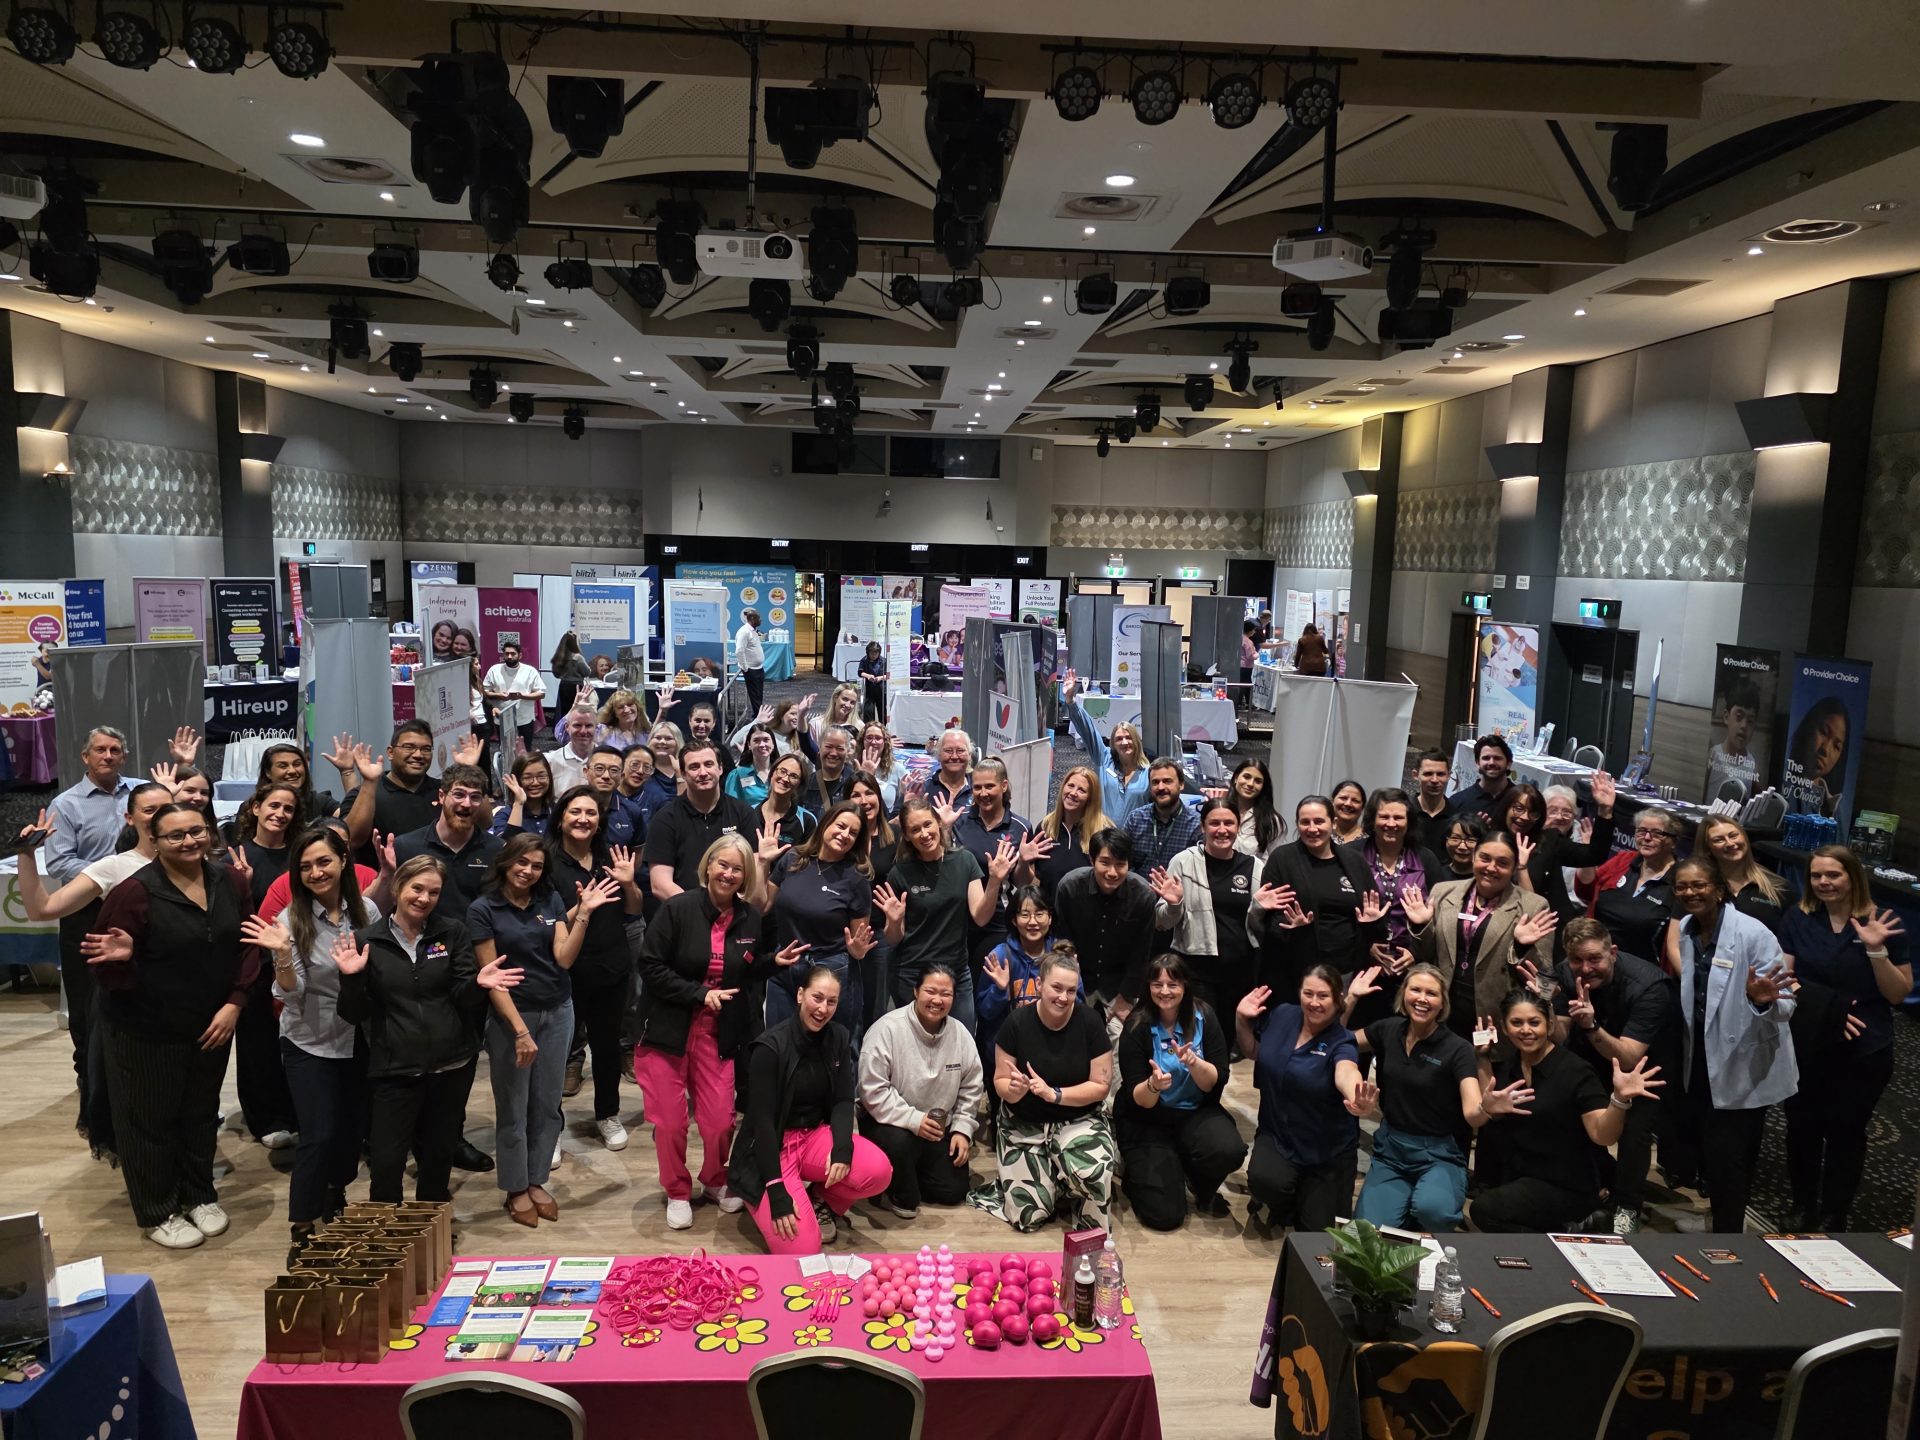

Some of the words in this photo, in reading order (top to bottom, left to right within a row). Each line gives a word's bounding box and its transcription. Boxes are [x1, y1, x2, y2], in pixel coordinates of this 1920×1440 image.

[575, 568, 596, 577] blitzit
[18, 591, 55, 600] McCall
[429, 595, 466, 606] Independent
[67, 612, 80, 620] Your
[81, 611, 93, 619] first
[439, 607, 457, 617] living
[485, 606, 532, 617] achieve
[68, 621, 72, 629] 4
[73, 621, 89, 629] hours
[1728, 658, 1751, 669] Provider
[1751, 661, 1770, 672] Choice
[1809, 667, 1836, 680] Provider
[1836, 671, 1860, 684] Choice
[222, 699, 288, 716] Hireup
[1508, 711, 1526, 720] REAL
[988, 729, 1012, 744] PARAMOUNT
[1737, 755, 1755, 769] Plan
[1787, 758, 1804, 774] The
[1707, 760, 1760, 783] Management
[1785, 772, 1814, 789] Power
[1783, 784, 1792, 795] of
[1792, 787, 1821, 804] Choice
[426, 950, 448, 960] McCall
[1625, 1355, 1735, 1415] elp
